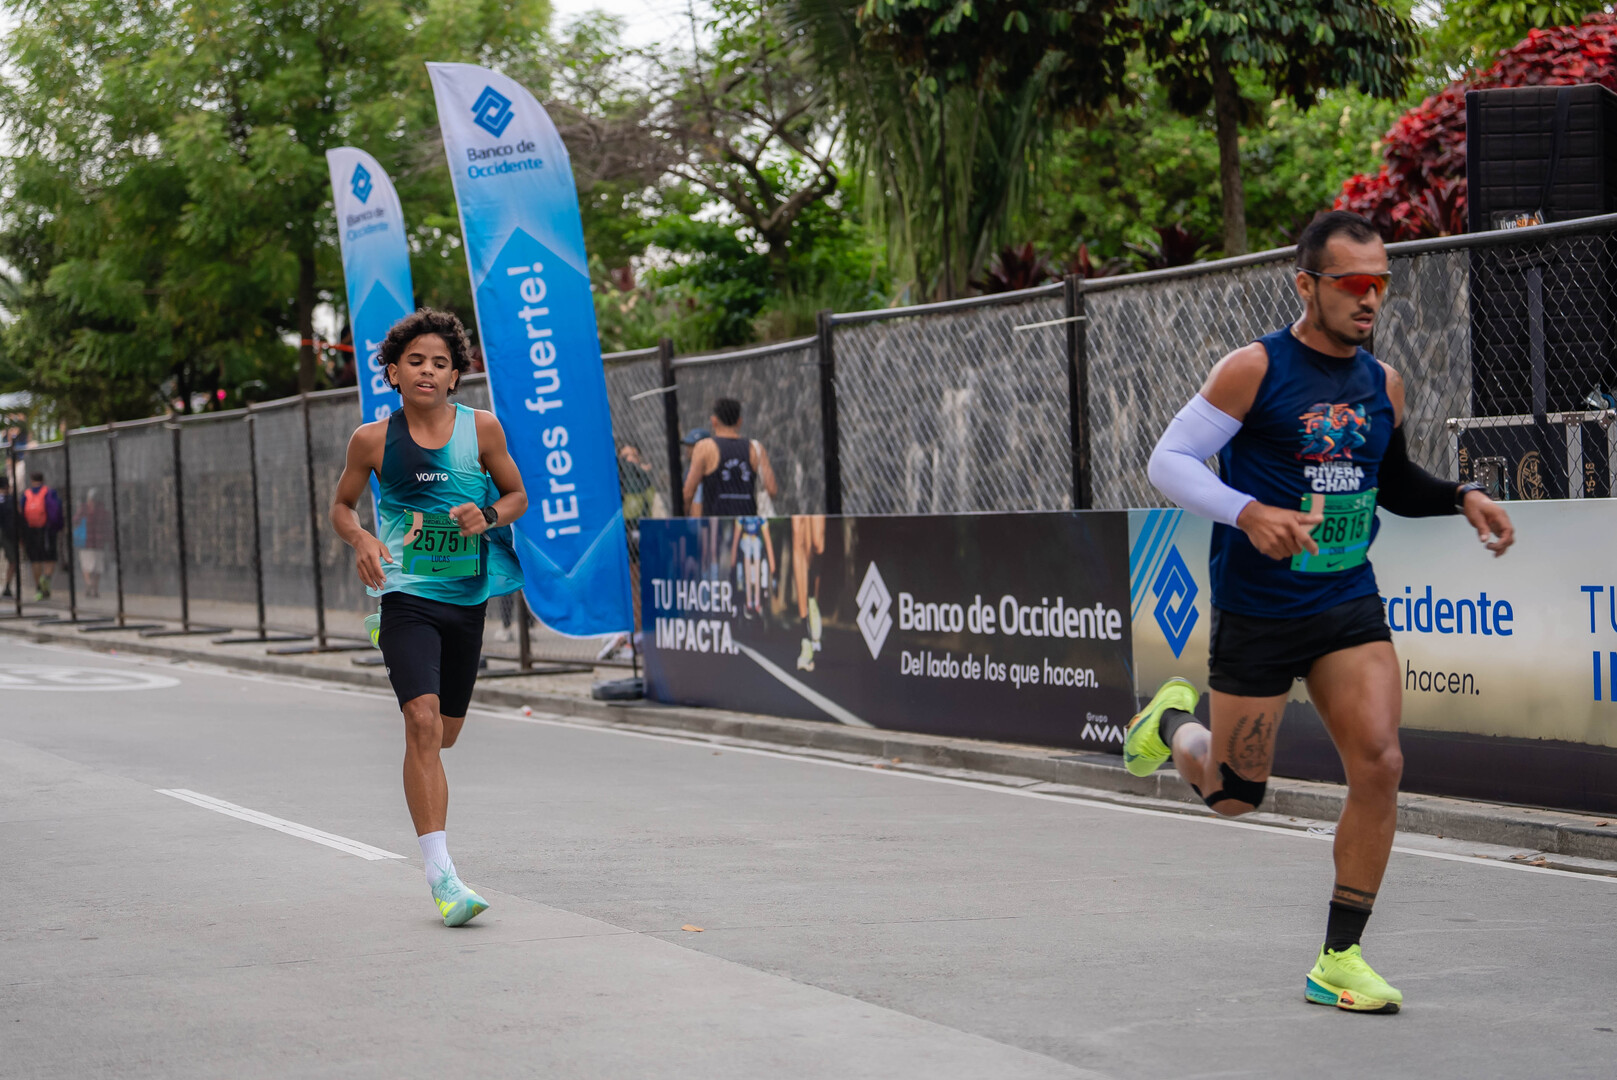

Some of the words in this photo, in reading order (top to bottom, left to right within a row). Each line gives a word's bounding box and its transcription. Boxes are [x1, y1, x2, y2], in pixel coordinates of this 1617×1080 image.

[466, 144, 514, 162] Banco
[517, 140, 536, 154] de
[467, 157, 544, 180] Occidente
[506, 261, 564, 415] fuerte!
[542, 425, 580, 539] ¡Eres
[1303, 465, 1365, 479] RIVERA
[1311, 478, 1361, 493] CHAN
[412, 529, 468, 553] 25751
[431, 554, 451, 563] LUCAS
[651, 578, 674, 611] TU
[676, 580, 738, 618] HACER,
[898, 592, 964, 633] Banco
[967, 594, 996, 635] de
[999, 595, 1122, 641] Occidente
[654, 617, 740, 655] IMPACTA.
[901, 651, 924, 677] Del
[926, 652, 960, 679] lado
[961, 653, 981, 680] de
[984, 654, 1007, 683] los
[1009, 664, 1039, 690] que
[1043, 657, 1099, 689] hacen.
[1405, 659, 1480, 696] hacen.
[1086, 711, 1108, 723] Grupo
